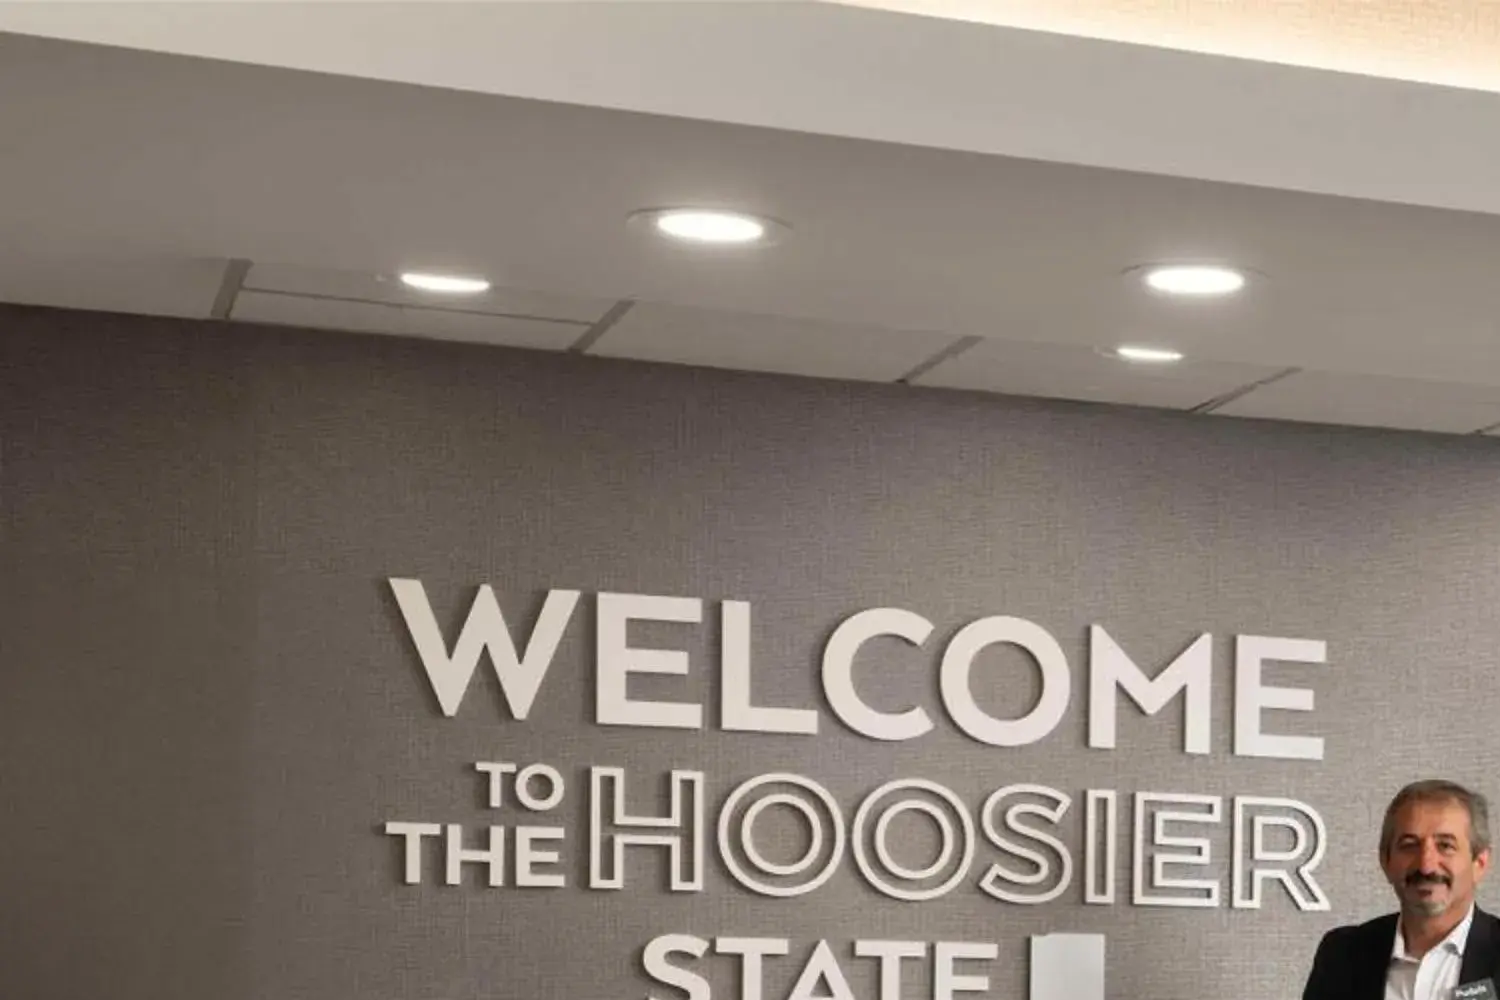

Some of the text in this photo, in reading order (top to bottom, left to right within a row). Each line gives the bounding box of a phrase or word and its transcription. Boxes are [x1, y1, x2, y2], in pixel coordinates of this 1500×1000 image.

[387, 577, 1329, 762] WELCOME
[385, 764, 1333, 913] THE HOOSIER
[475, 761, 566, 812] TO
